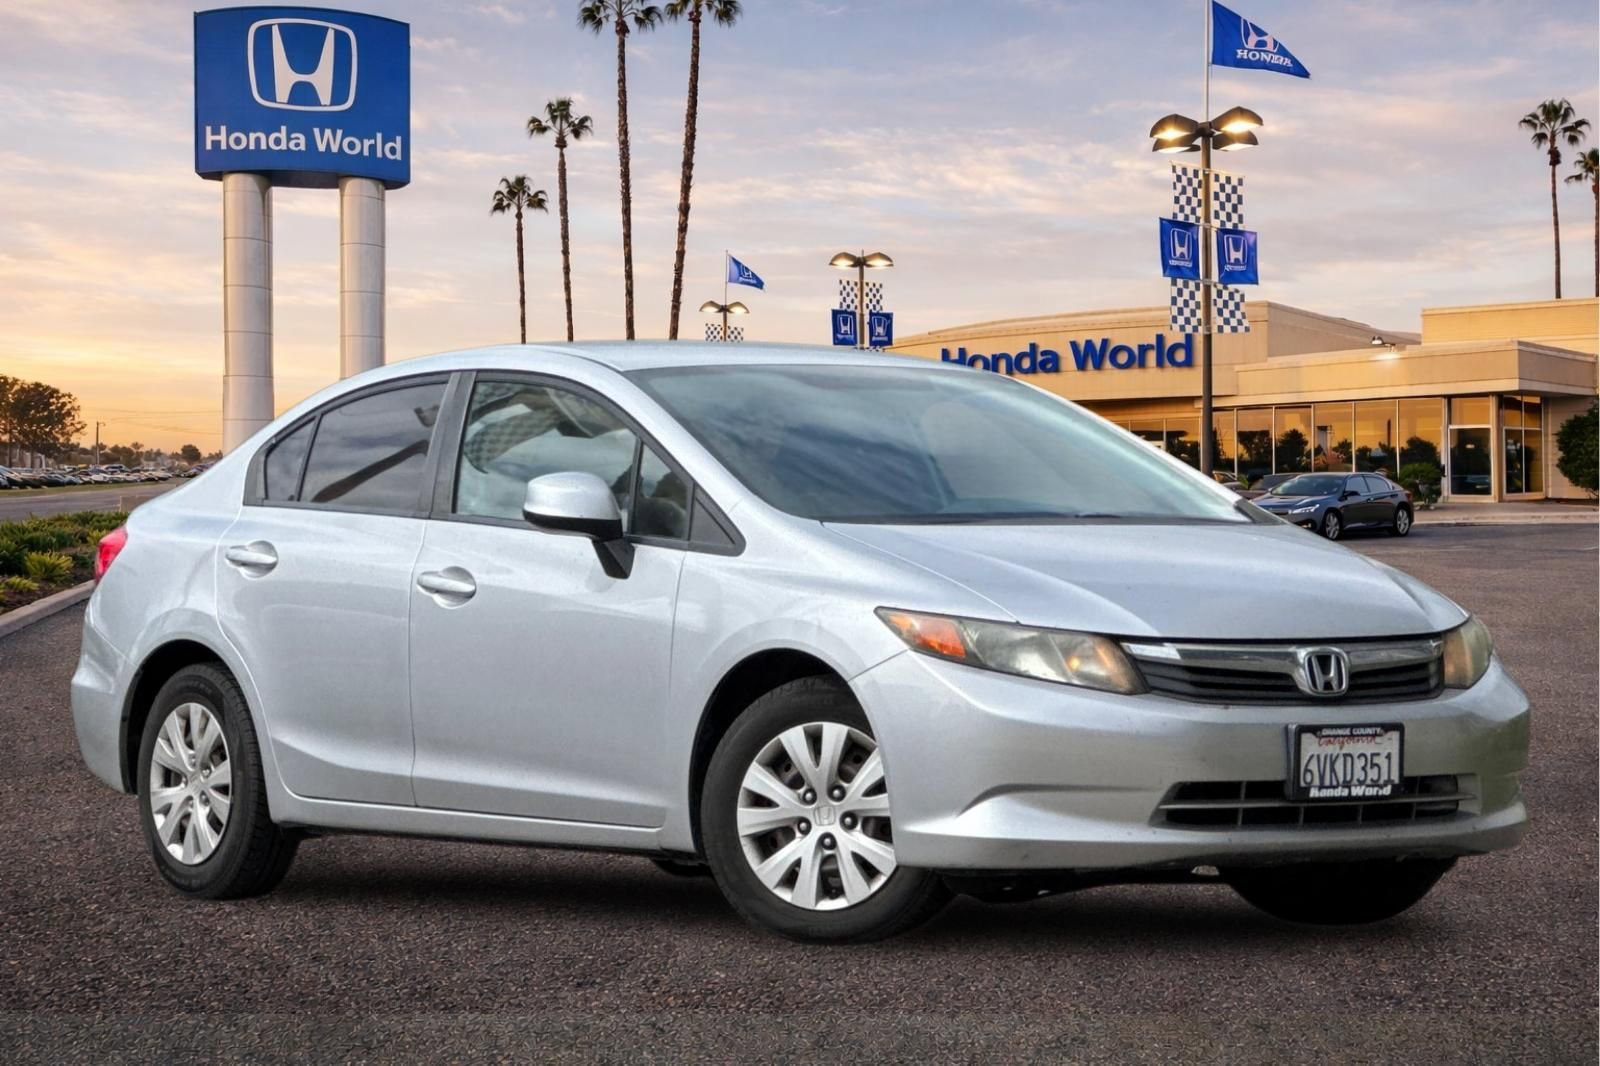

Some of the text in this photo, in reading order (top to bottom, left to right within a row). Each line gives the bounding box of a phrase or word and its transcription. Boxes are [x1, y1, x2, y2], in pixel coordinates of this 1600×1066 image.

[205, 125, 402, 161] Honda World
[1069, 333, 1194, 372] World
[1352, 727, 1381, 736] COUNTY
[1303, 751, 1396, 786] 6VKD351
